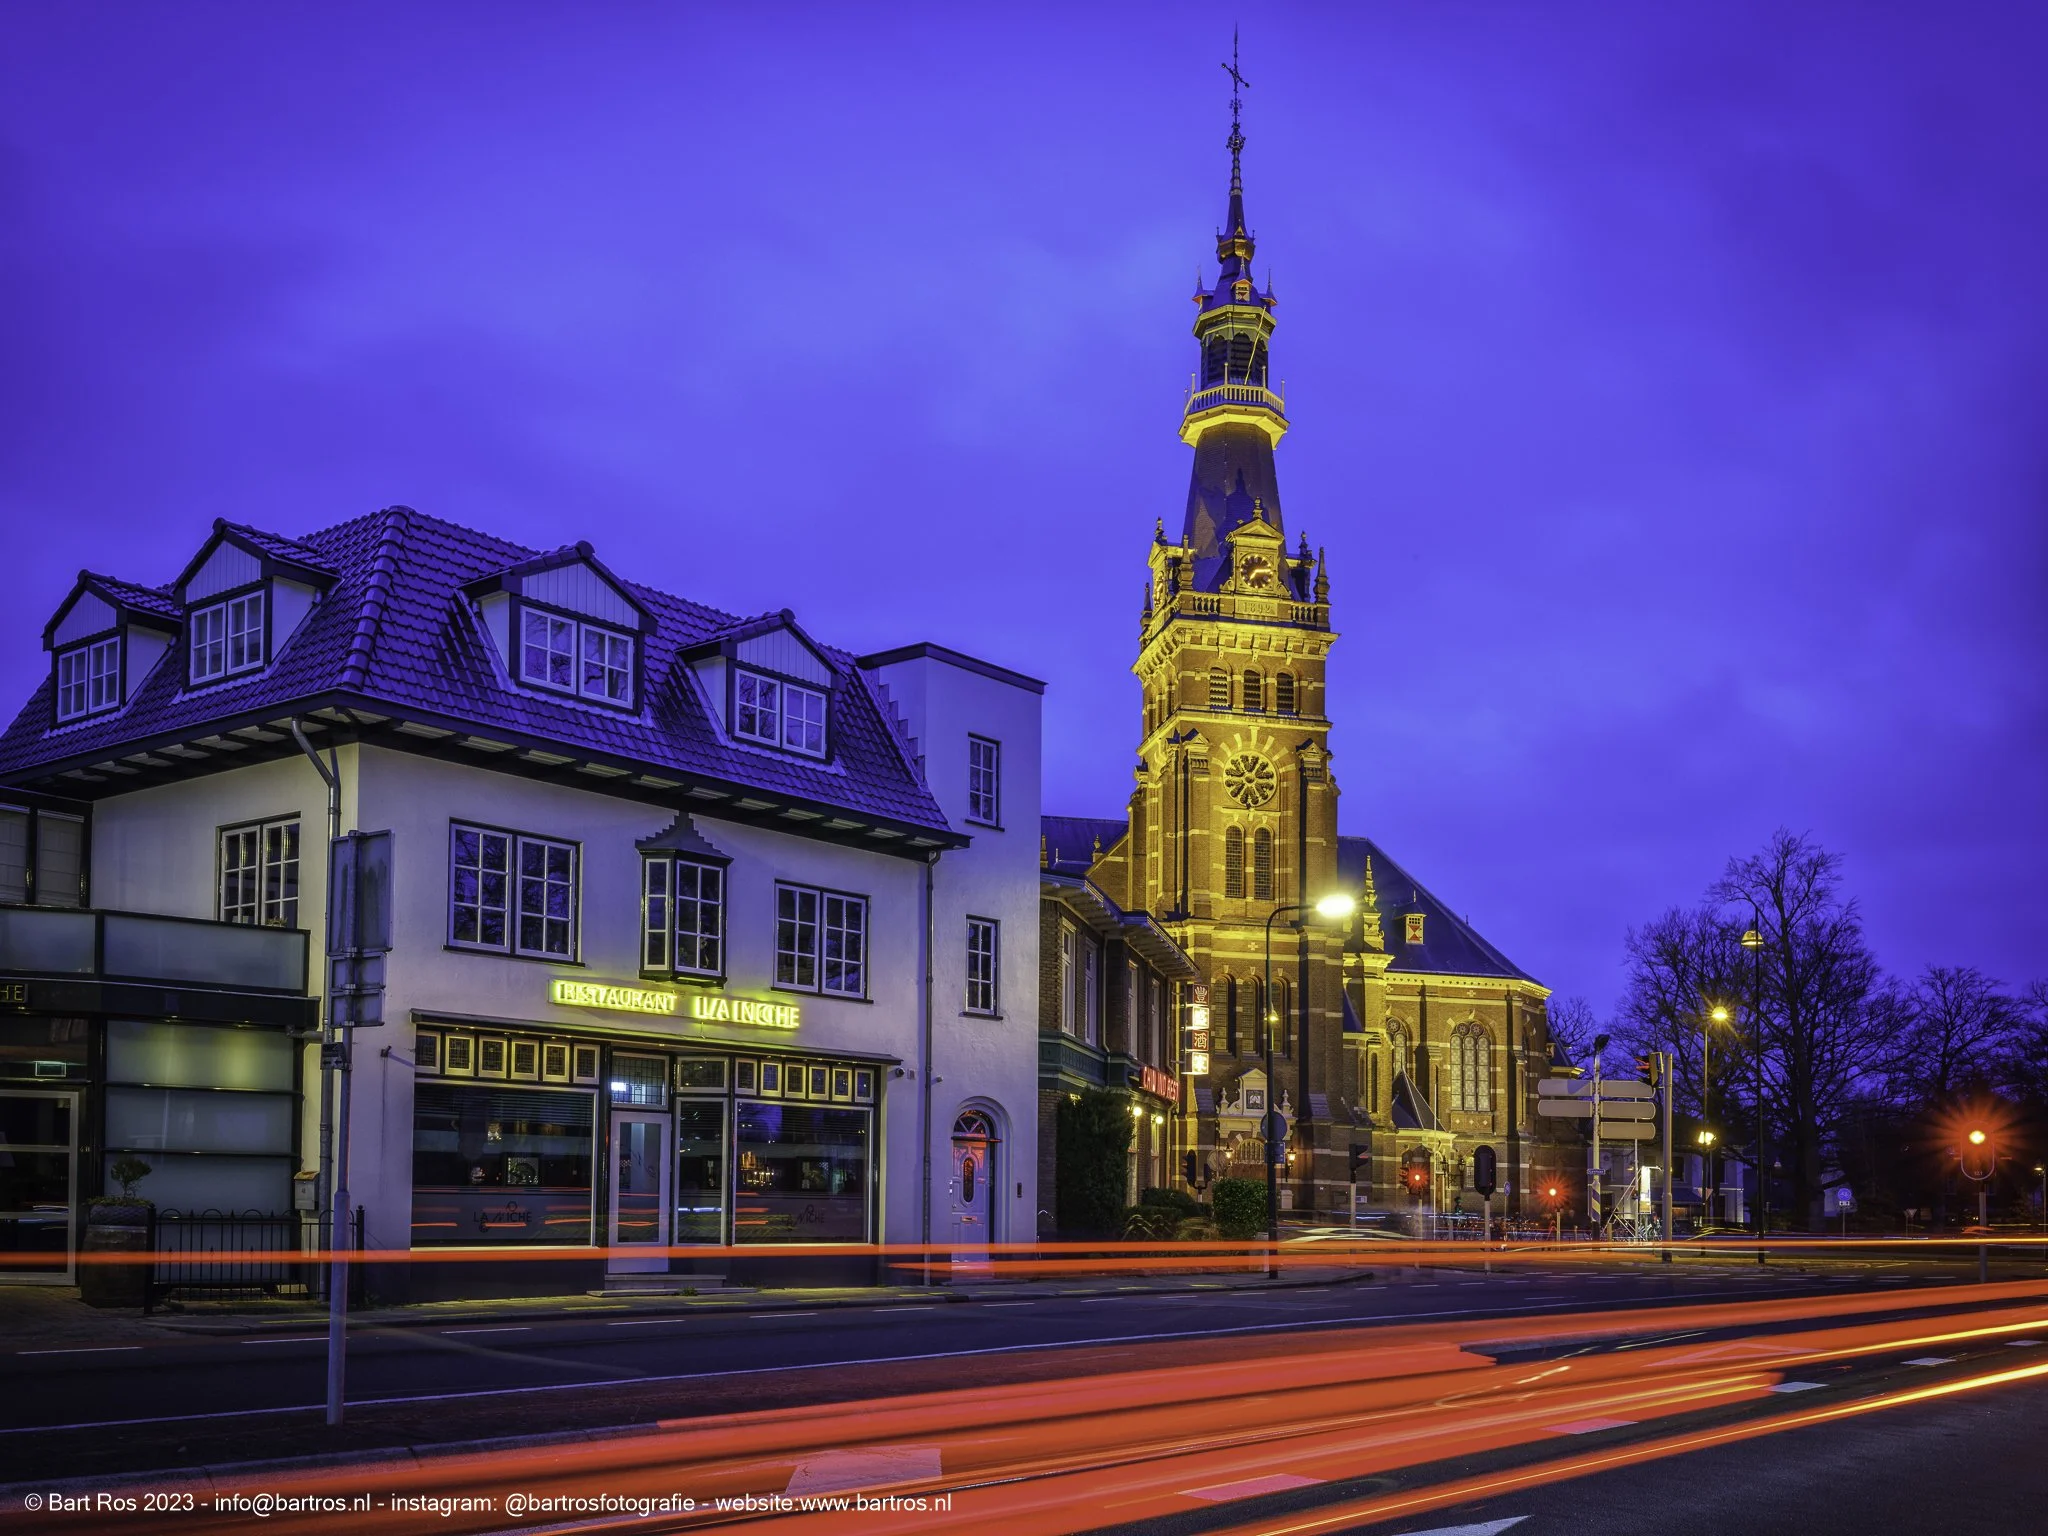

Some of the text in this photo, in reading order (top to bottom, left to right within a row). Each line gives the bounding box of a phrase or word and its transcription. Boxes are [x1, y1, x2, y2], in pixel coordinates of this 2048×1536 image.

[556, 982, 800, 1029] RESTAURANT LA NICHE
